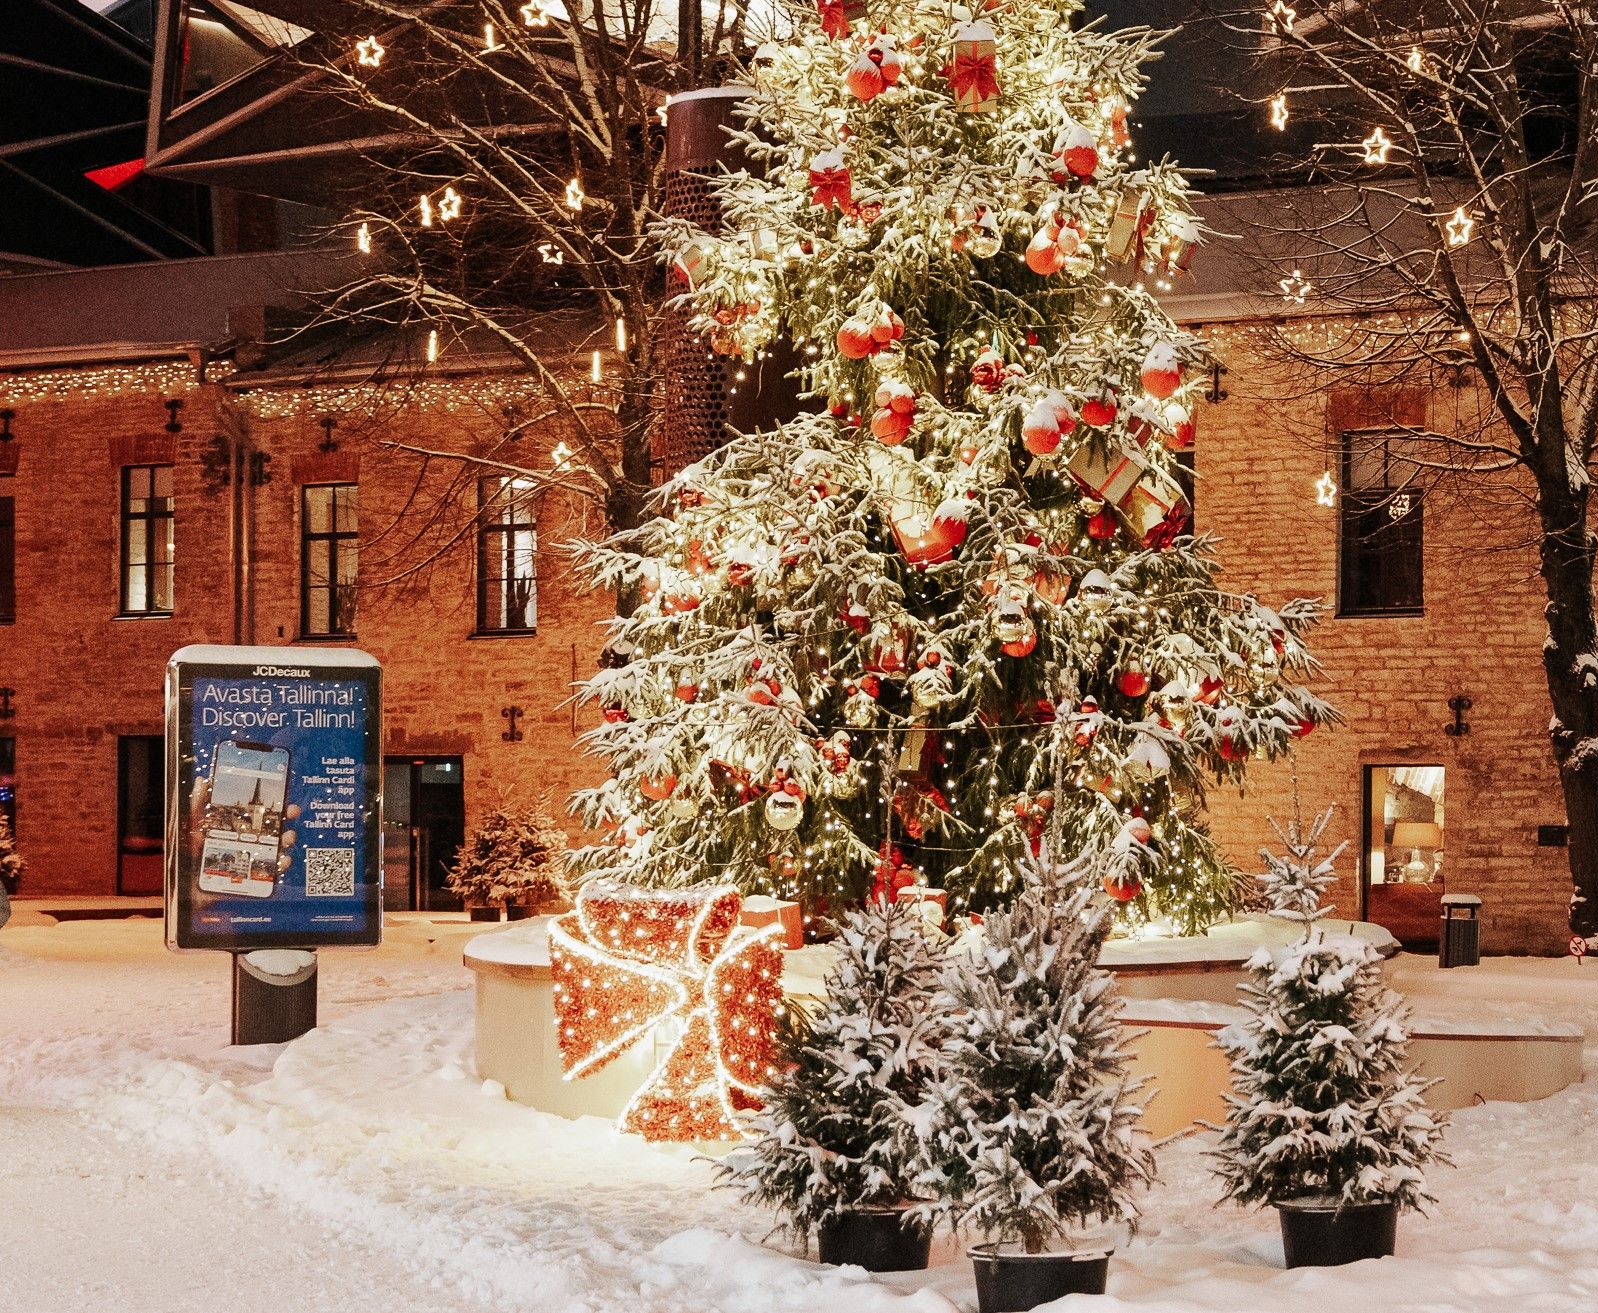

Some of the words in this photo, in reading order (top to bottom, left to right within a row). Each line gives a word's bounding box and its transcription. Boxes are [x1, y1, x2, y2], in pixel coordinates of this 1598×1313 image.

[253, 666, 310, 677] JCDecaux
[203, 684, 272, 704] Avasta
[276, 685, 353, 705] Tallinna!
[203, 707, 287, 727] Discover
[292, 708, 355, 728] Tallinn!
[321, 756, 337, 765] Lae
[340, 756, 355, 765] alla
[326, 767, 355, 775] tasuta
[302, 775, 330, 784] Tallinn
[332, 776, 355, 784] Cardi
[338, 785, 355, 795] äpp
[310, 801, 355, 810] Download
[337, 811, 355, 820] free
[303, 820, 333, 829] Tallinn
[334, 820, 355, 828] Card
[338, 831, 355, 840] app
